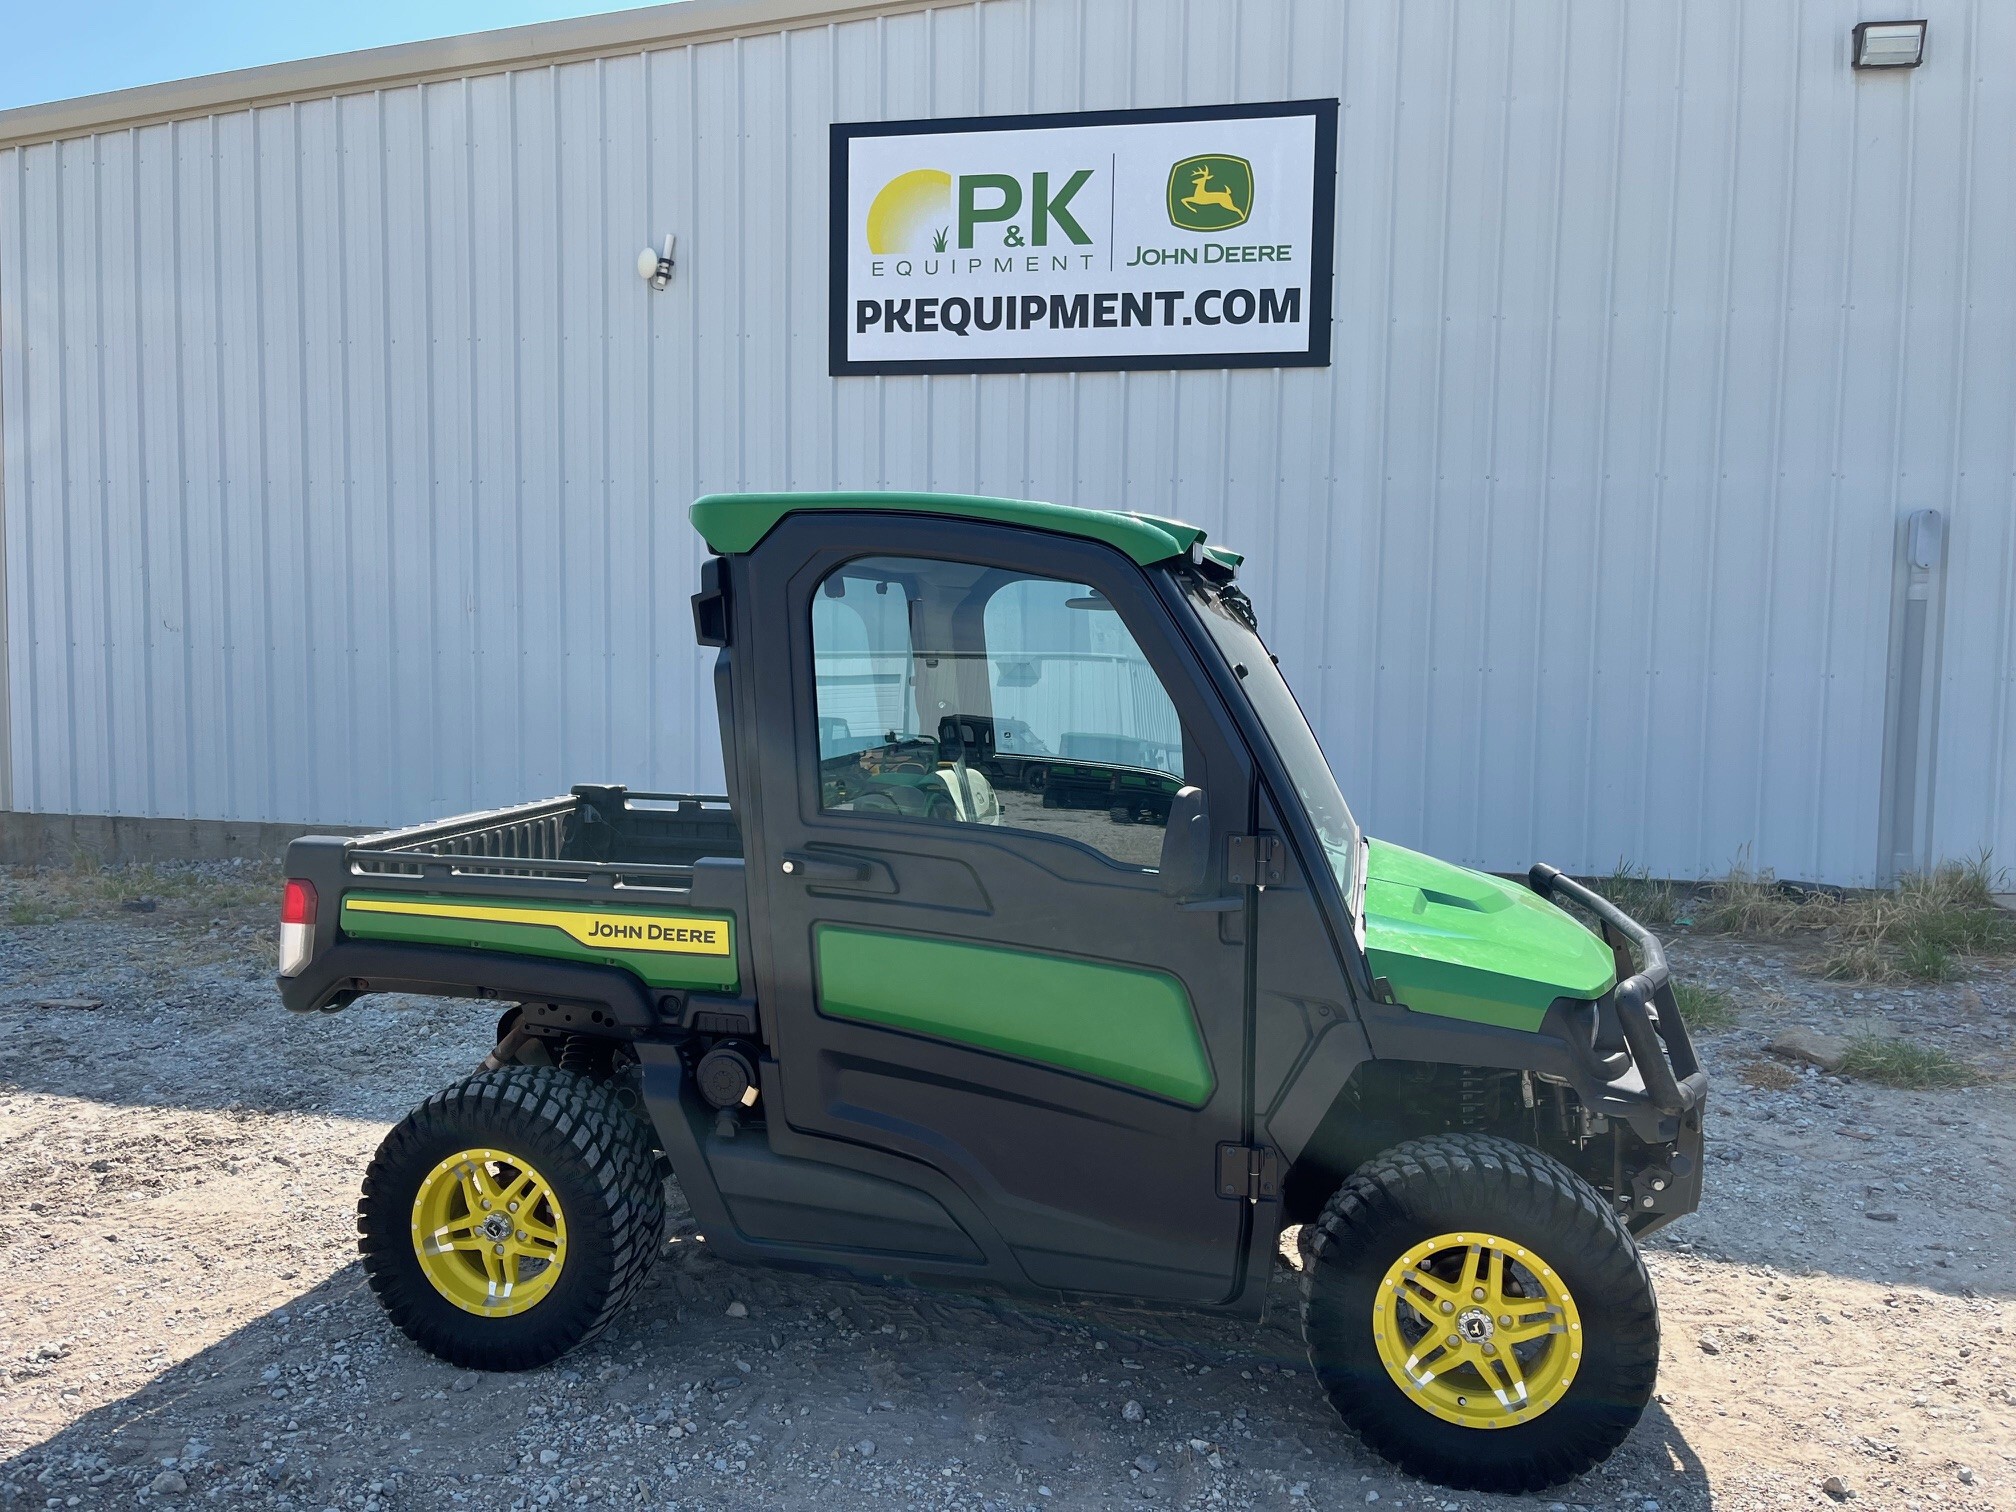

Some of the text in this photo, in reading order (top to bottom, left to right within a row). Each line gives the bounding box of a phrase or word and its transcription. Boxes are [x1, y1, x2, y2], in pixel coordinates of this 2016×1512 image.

[959, 170, 1094, 250] P&K
[872, 255, 1094, 277] EQUIPMENT
[1126, 243, 1292, 266] JOHN DEERE
[857, 287, 1301, 336] PKEQUIPMENT.COM
[588, 921, 716, 943] JOHN DEERE
